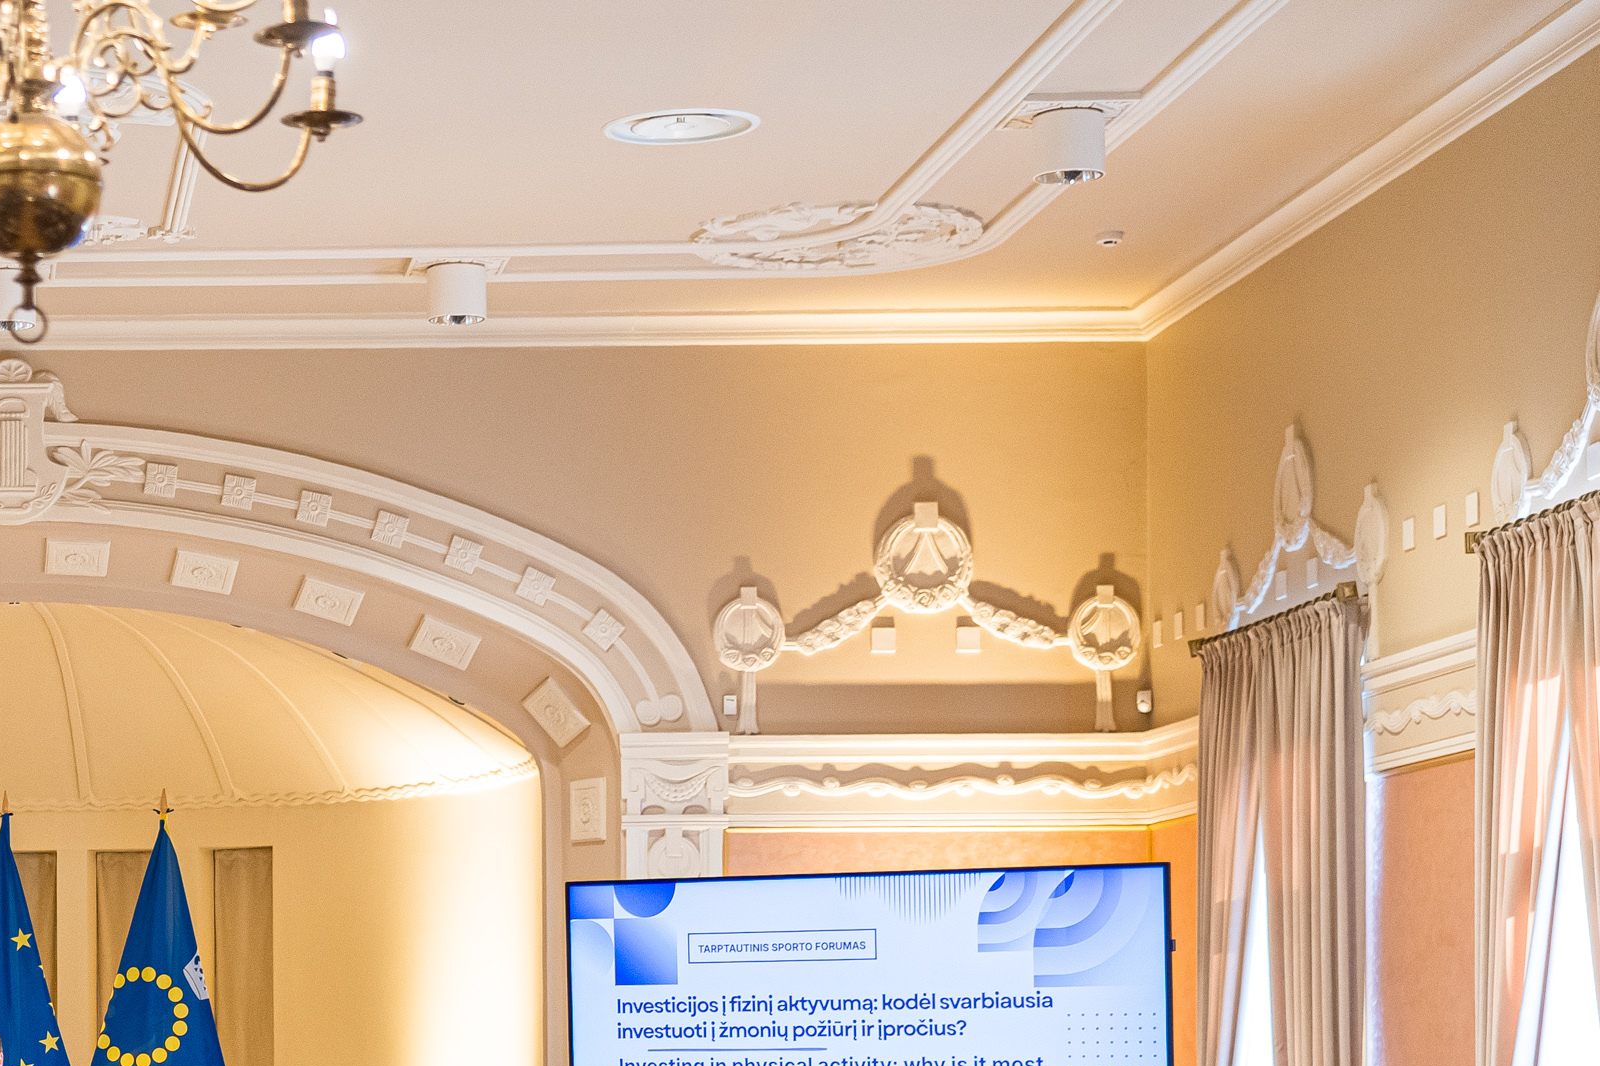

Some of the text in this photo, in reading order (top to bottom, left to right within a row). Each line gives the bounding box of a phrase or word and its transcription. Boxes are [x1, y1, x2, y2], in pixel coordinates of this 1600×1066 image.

[698, 941, 866, 953] TARPTAUTINIS SPORTO FORUMAS
[617, 991, 1053, 1017] Investicijos į fizinį aktyvumą: kodėl svarbiausia
[617, 1018, 967, 1042] investuoti į žmonių požiūrį ir įpročius?
